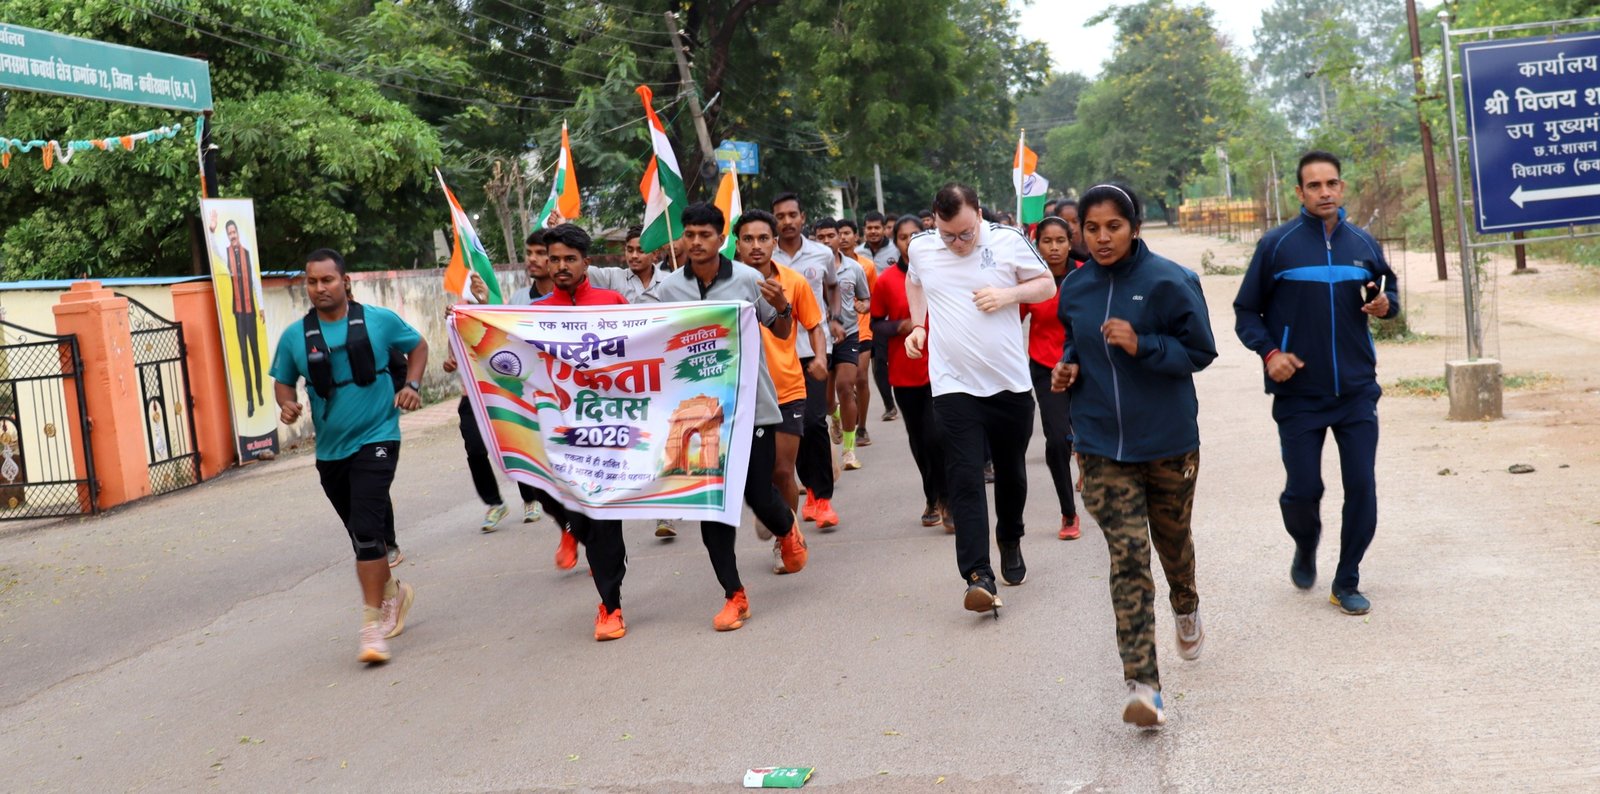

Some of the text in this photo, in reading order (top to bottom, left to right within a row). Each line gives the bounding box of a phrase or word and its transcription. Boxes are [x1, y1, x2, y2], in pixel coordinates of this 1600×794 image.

[56, 57, 72, 82] क्षेत्र
[72, 63, 97, 86] क्रमांक
[111, 67, 134, 91] जिला
[1518, 53, 1597, 78] कार्यालय
[1484, 89, 1509, 115] श्री
[1515, 87, 1576, 113] विजय
[1505, 123, 1534, 140] उप
[1533, 140, 1597, 158] छ.ग.शासन
[539, 321, 557, 331] एक
[562, 321, 588, 331] भारत
[597, 318, 618, 330] श्रेष्ठ
[622, 318, 648, 328] भारत
[680, 328, 717, 344] संगठित
[687, 340, 717, 353] भारत
[688, 352, 718, 368] समृद्ध
[698, 364, 723, 377] भारत
[537, 358, 665, 410] एकता
[574, 389, 651, 423] दिवस
[575, 427, 630, 446] 2026
